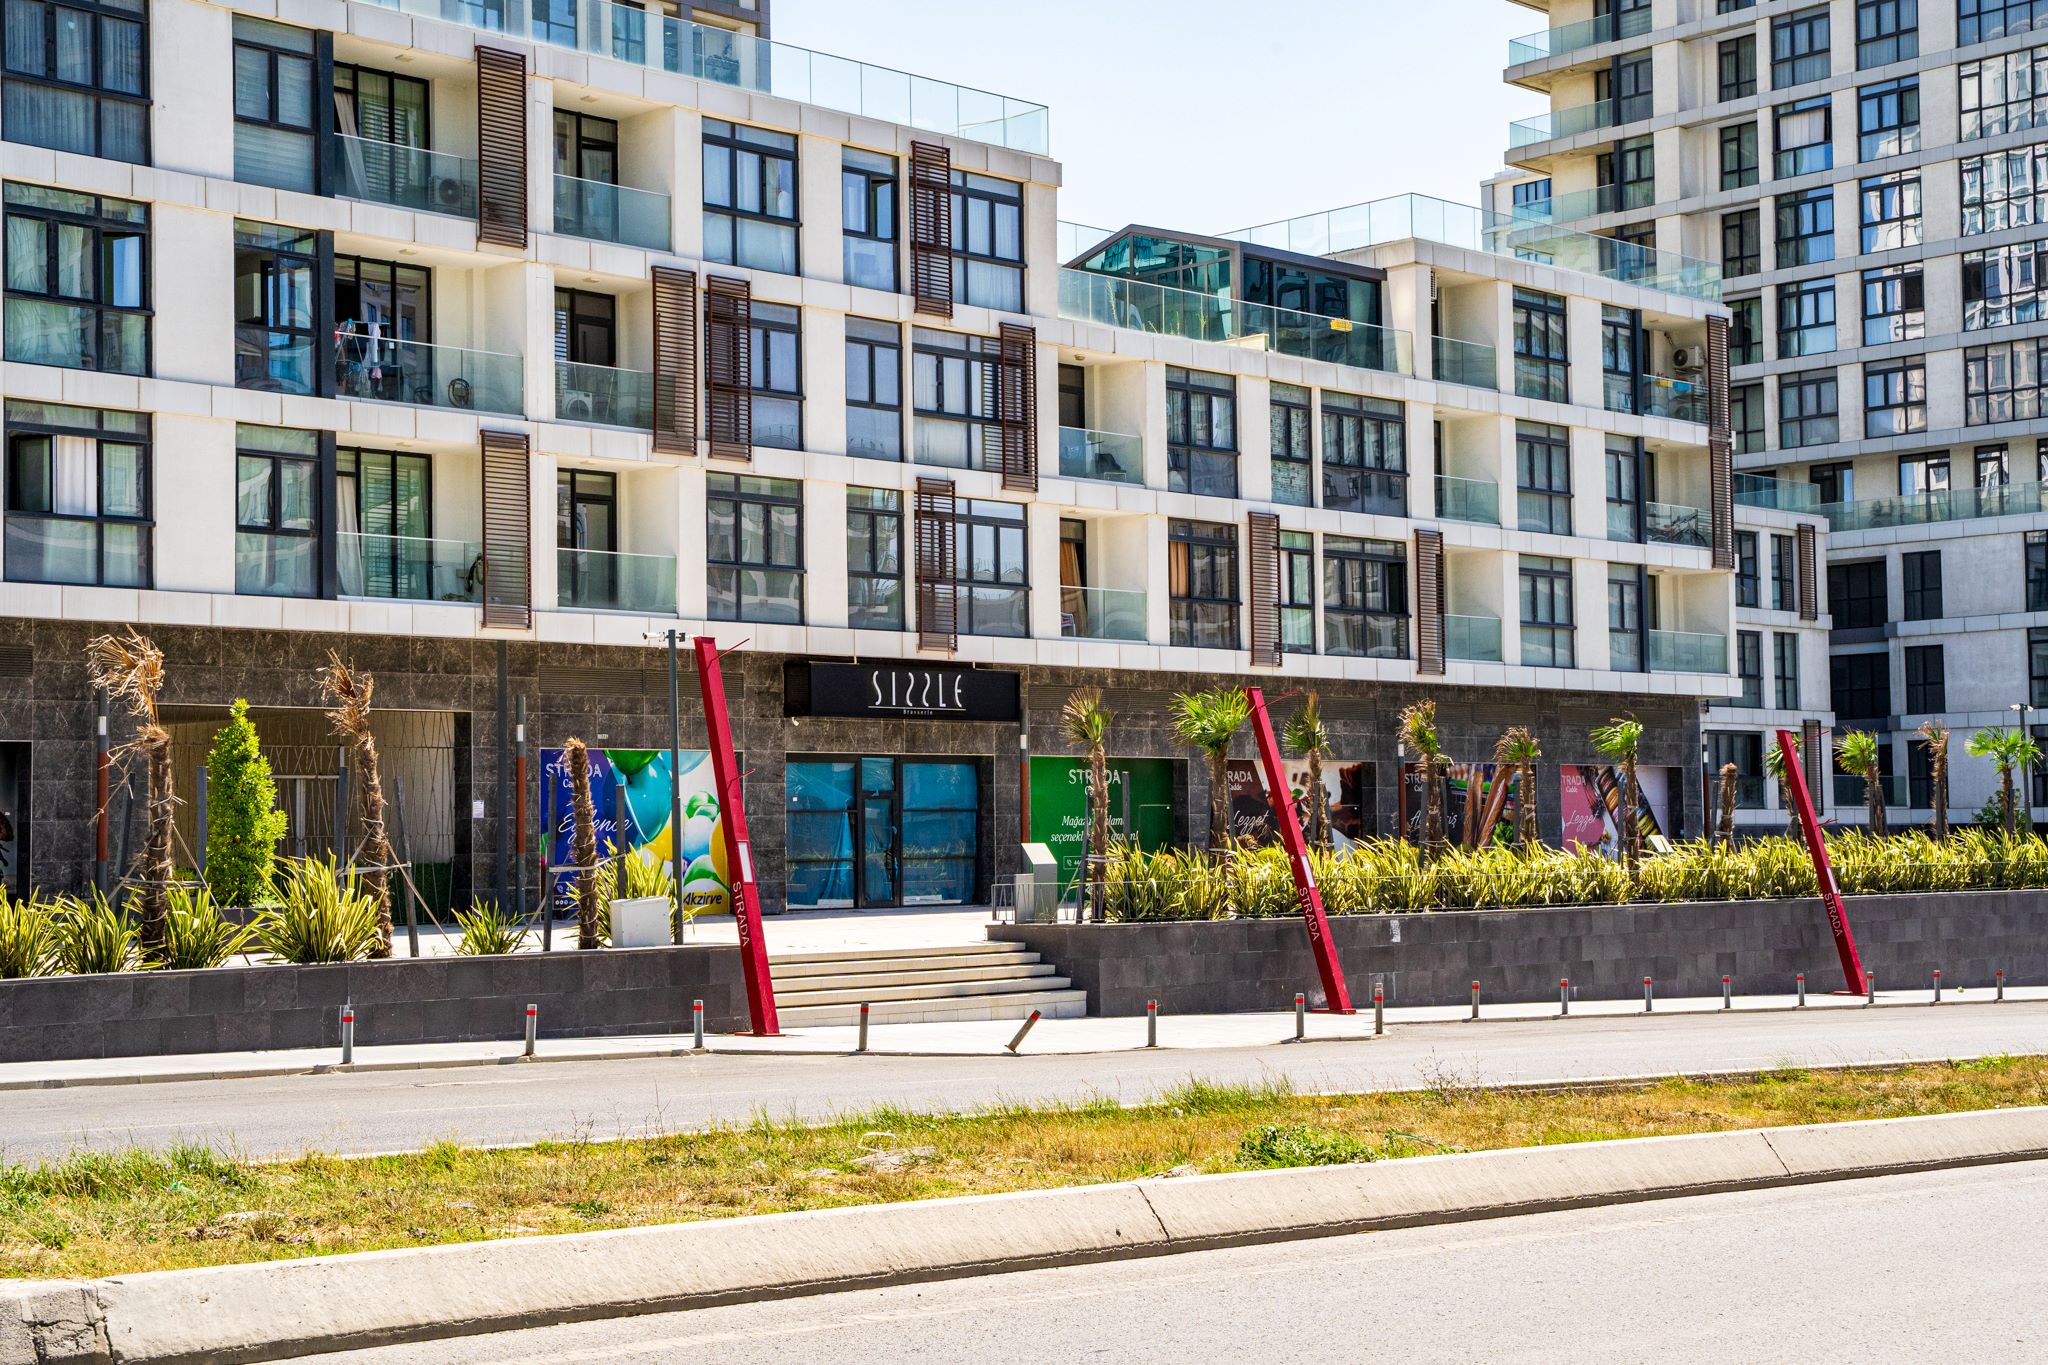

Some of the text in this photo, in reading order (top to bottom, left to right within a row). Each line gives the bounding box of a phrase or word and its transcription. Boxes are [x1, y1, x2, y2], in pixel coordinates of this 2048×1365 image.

[545, 763, 603, 778] STRDA
[1068, 769, 1122, 785] STRDA
[1227, 770, 1253, 783] RADA
[1405, 772, 1425, 784] STRA
[1561, 775, 1587, 786] TRADA
[558, 809, 633, 844] Eence
[1566, 810, 1600, 832] Lezzet
[683, 892, 722, 906] Akzirve
[732, 881, 750, 948] STRADA
[1299, 887, 1320, 941] STRADA
[1824, 892, 1843, 937] STRADA
